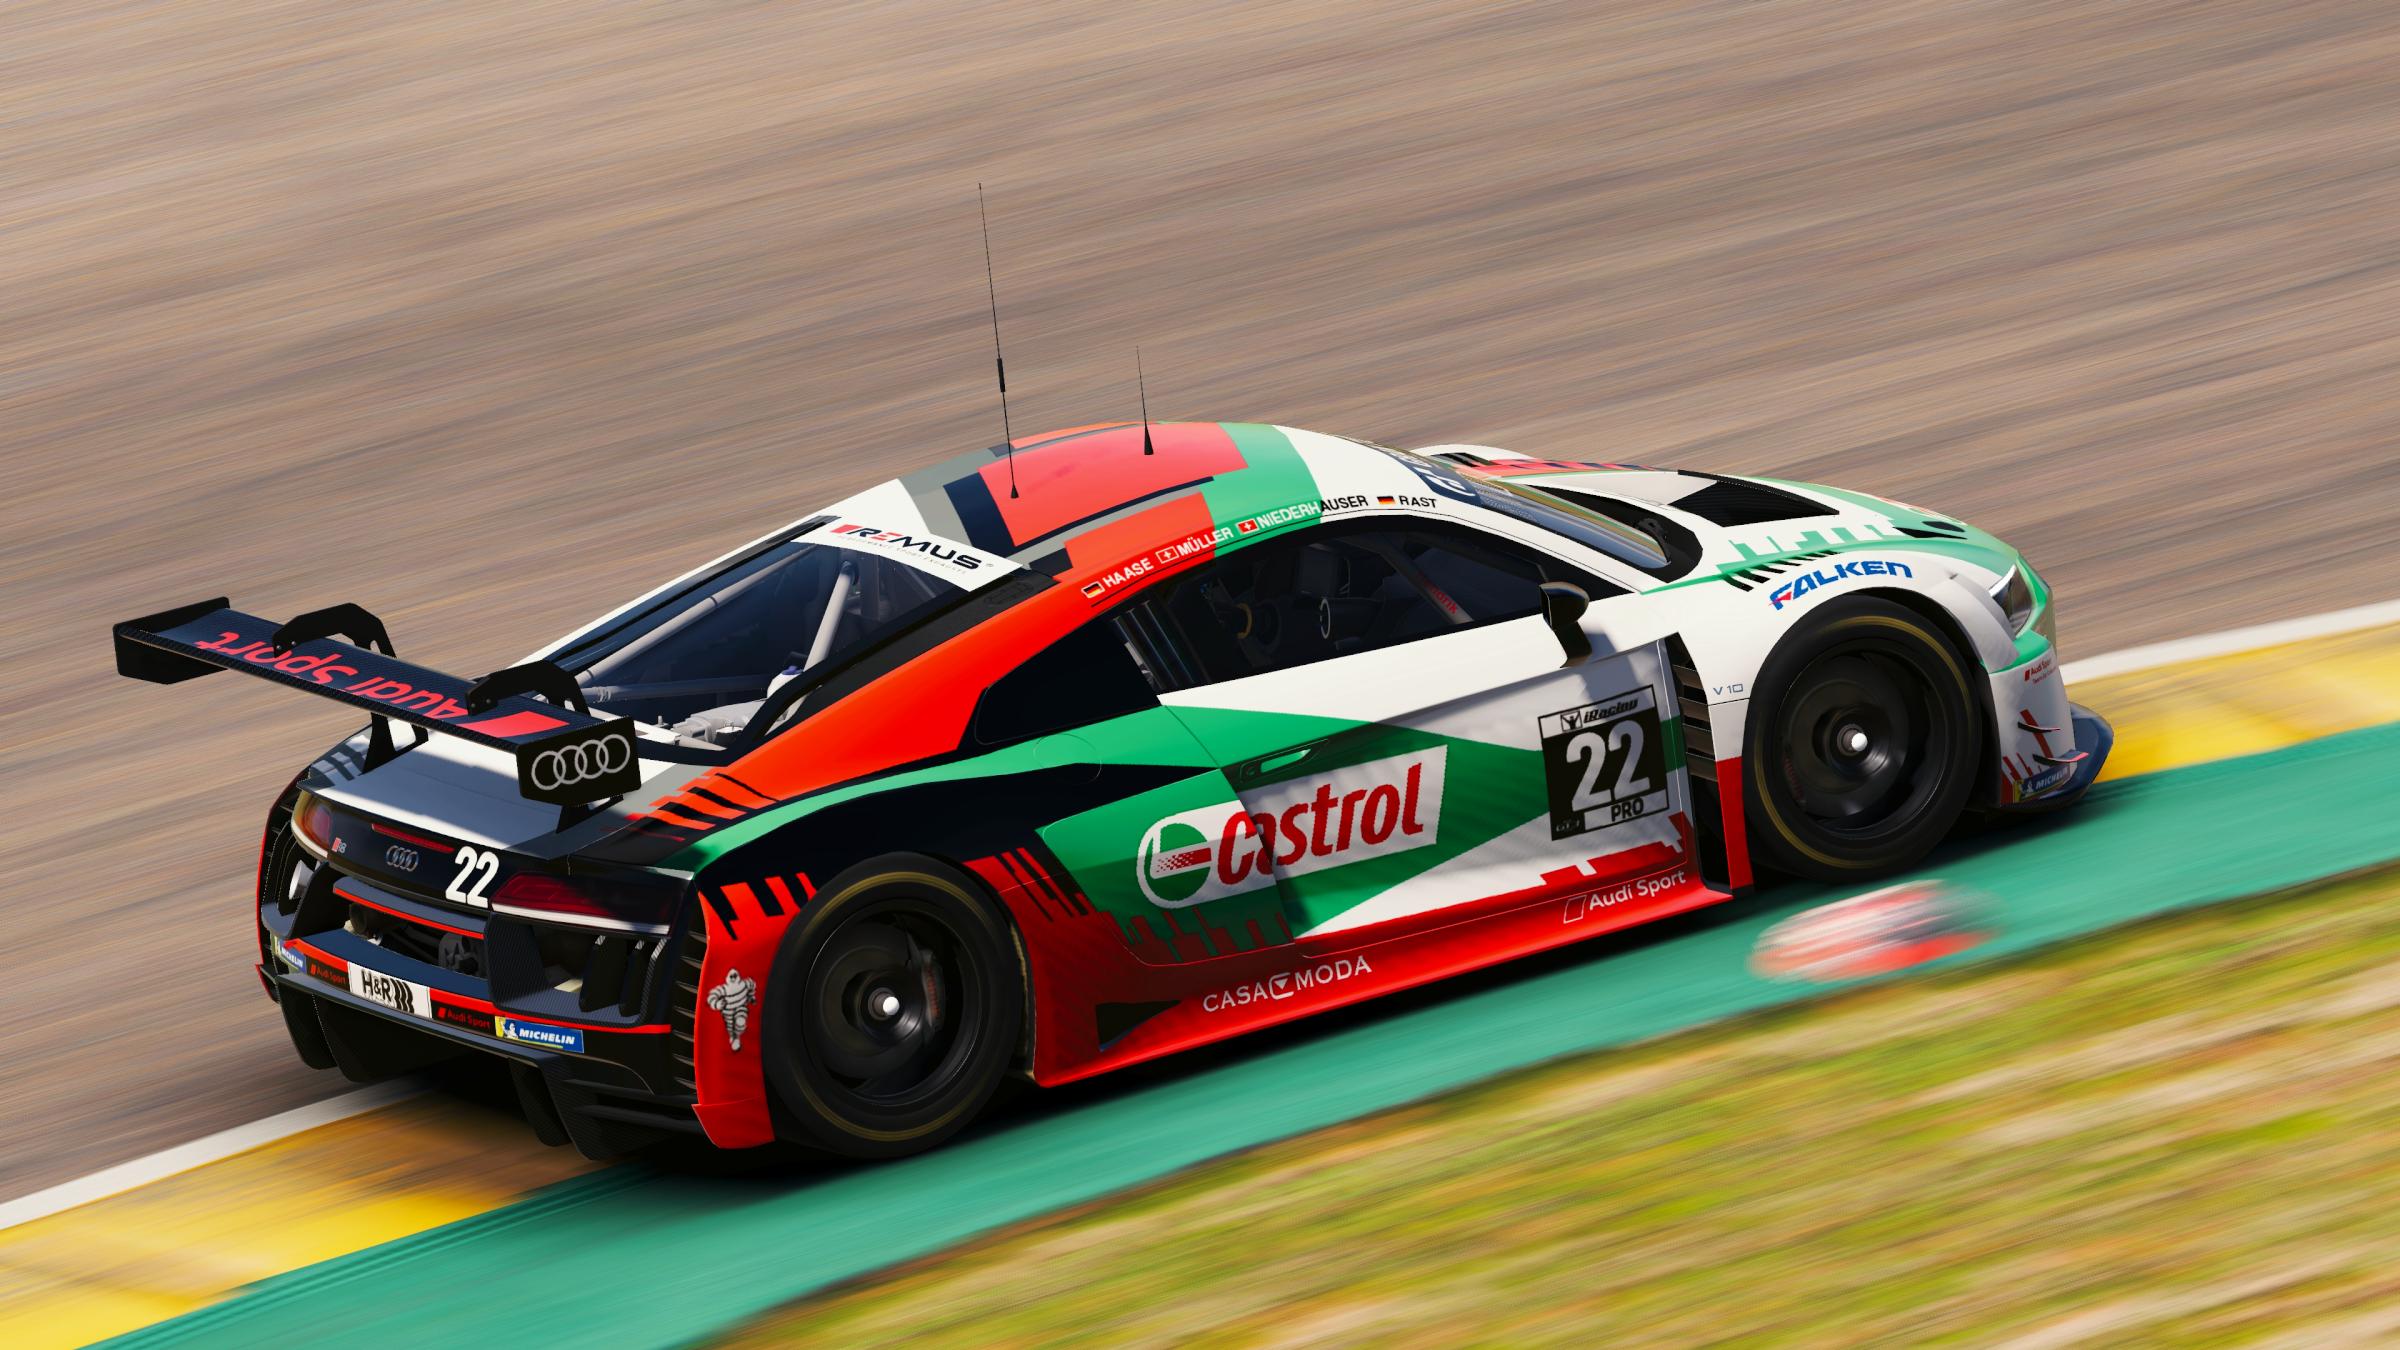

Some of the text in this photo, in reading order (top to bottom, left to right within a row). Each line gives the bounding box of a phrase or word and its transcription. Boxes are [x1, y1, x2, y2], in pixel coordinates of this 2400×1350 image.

[845, 527, 982, 570] REMUS
[1102, 494, 1438, 587] HAASE MÜLLER NIEDERHAUSER RAST
[1769, 560, 1913, 611] FALKEN
[194, 631, 469, 719] Audi Sport
[1566, 719, 1650, 812] 22
[1217, 762, 1424, 885] Castrol
[1611, 797, 1645, 822] PRO
[445, 845, 500, 909] 22
[1589, 871, 1687, 911] Audi Sport
[361, 968, 392, 1002] H&R
[519, 1027, 576, 1045] MICHELIN
